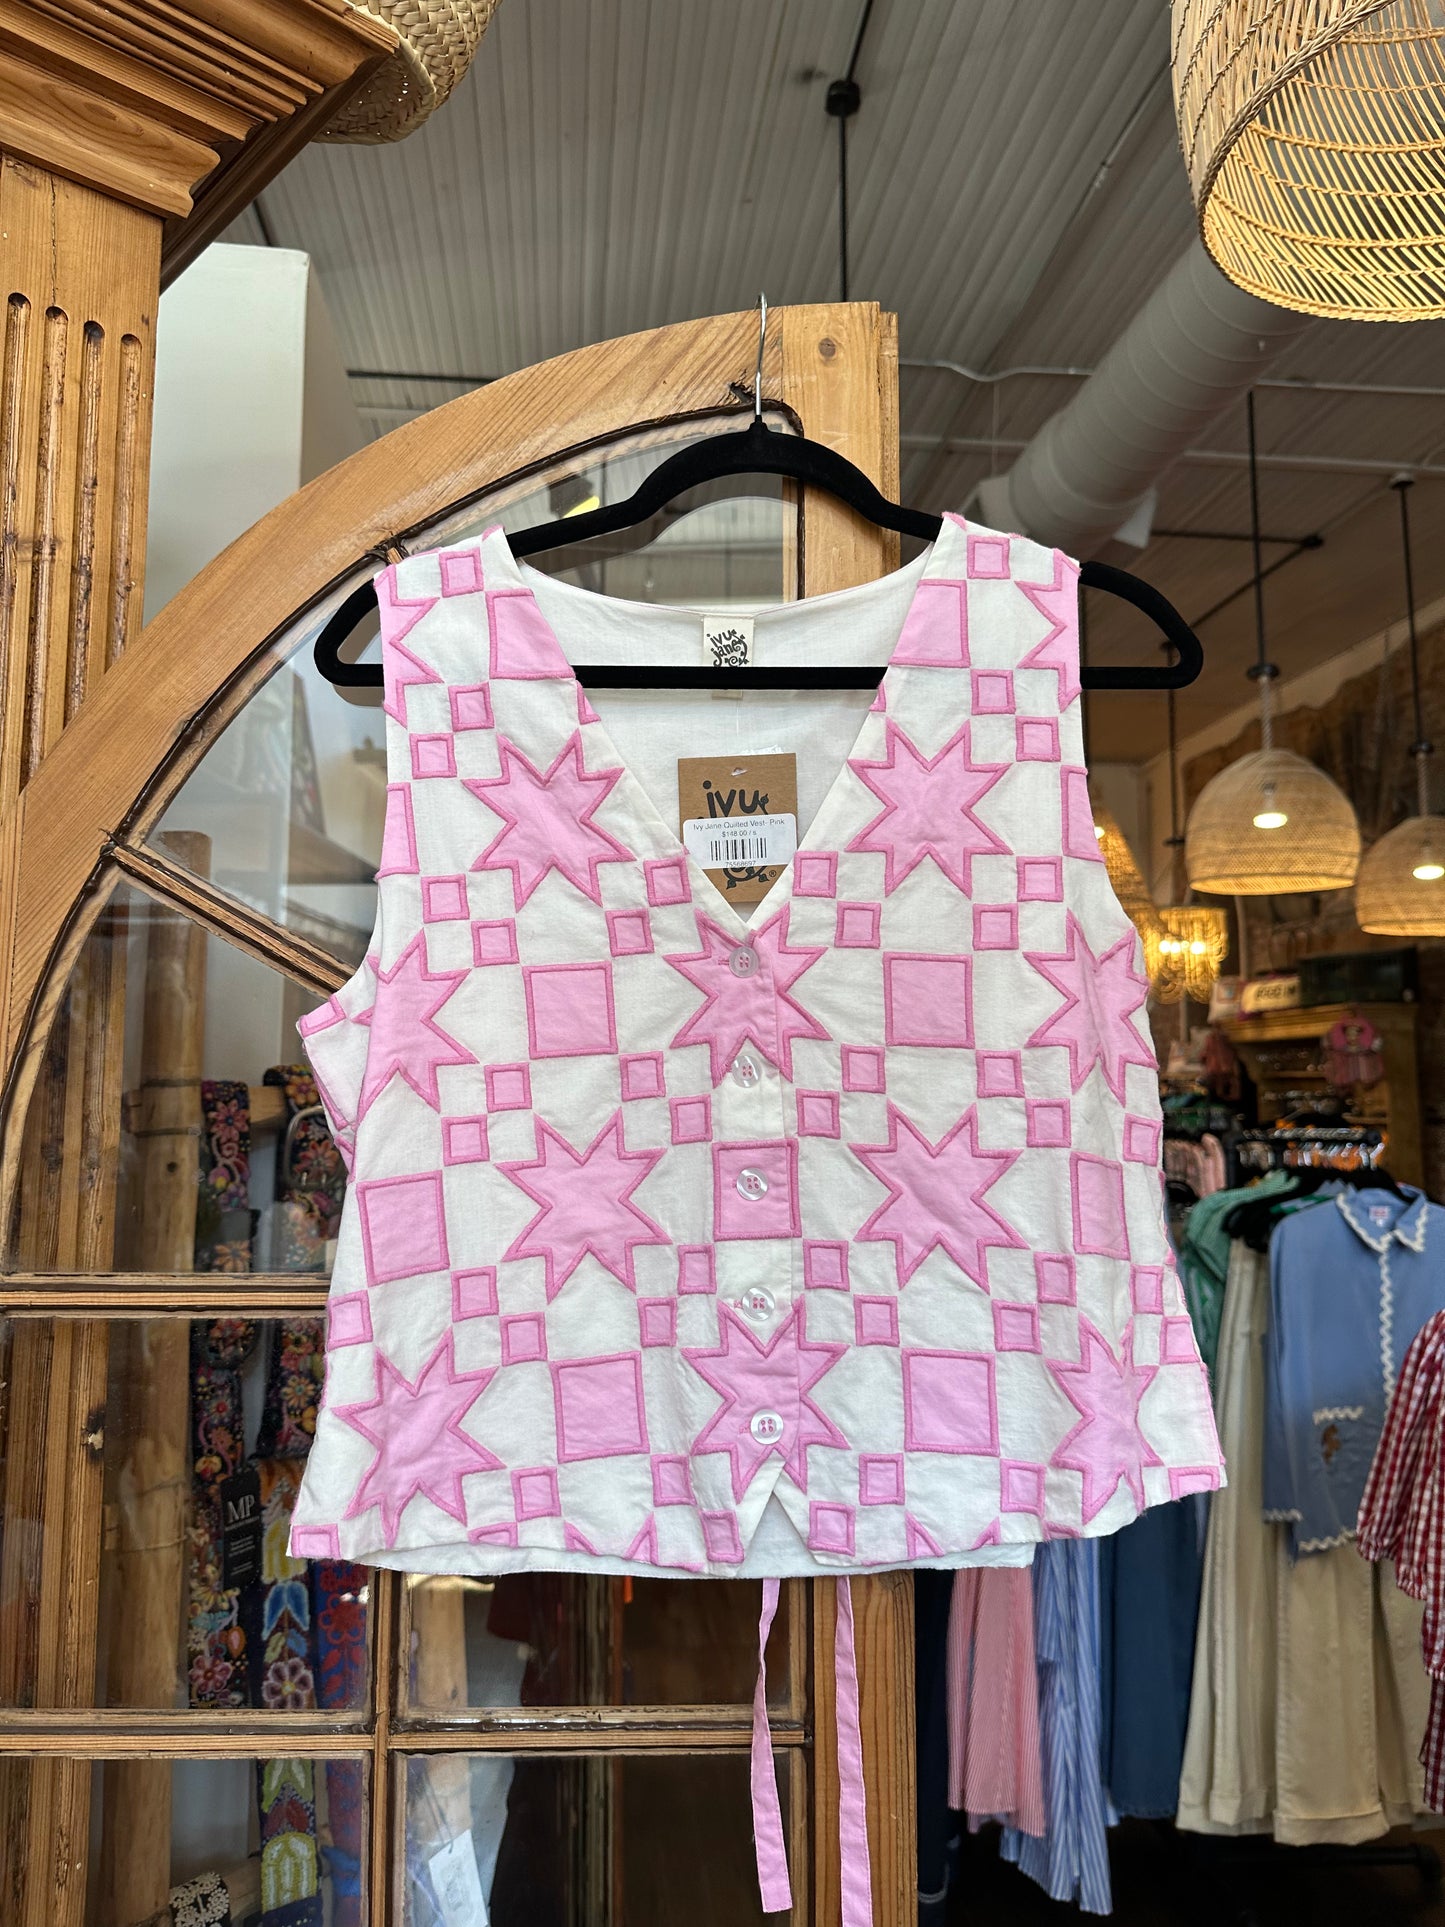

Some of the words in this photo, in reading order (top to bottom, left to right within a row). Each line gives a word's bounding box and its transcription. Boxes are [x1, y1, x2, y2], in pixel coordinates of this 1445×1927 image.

[693, 823, 704, 831] Ivy
[723, 821, 748, 829] Quilted
[769, 818, 785, 826] Pink
[227, 1494, 256, 1523] MP
